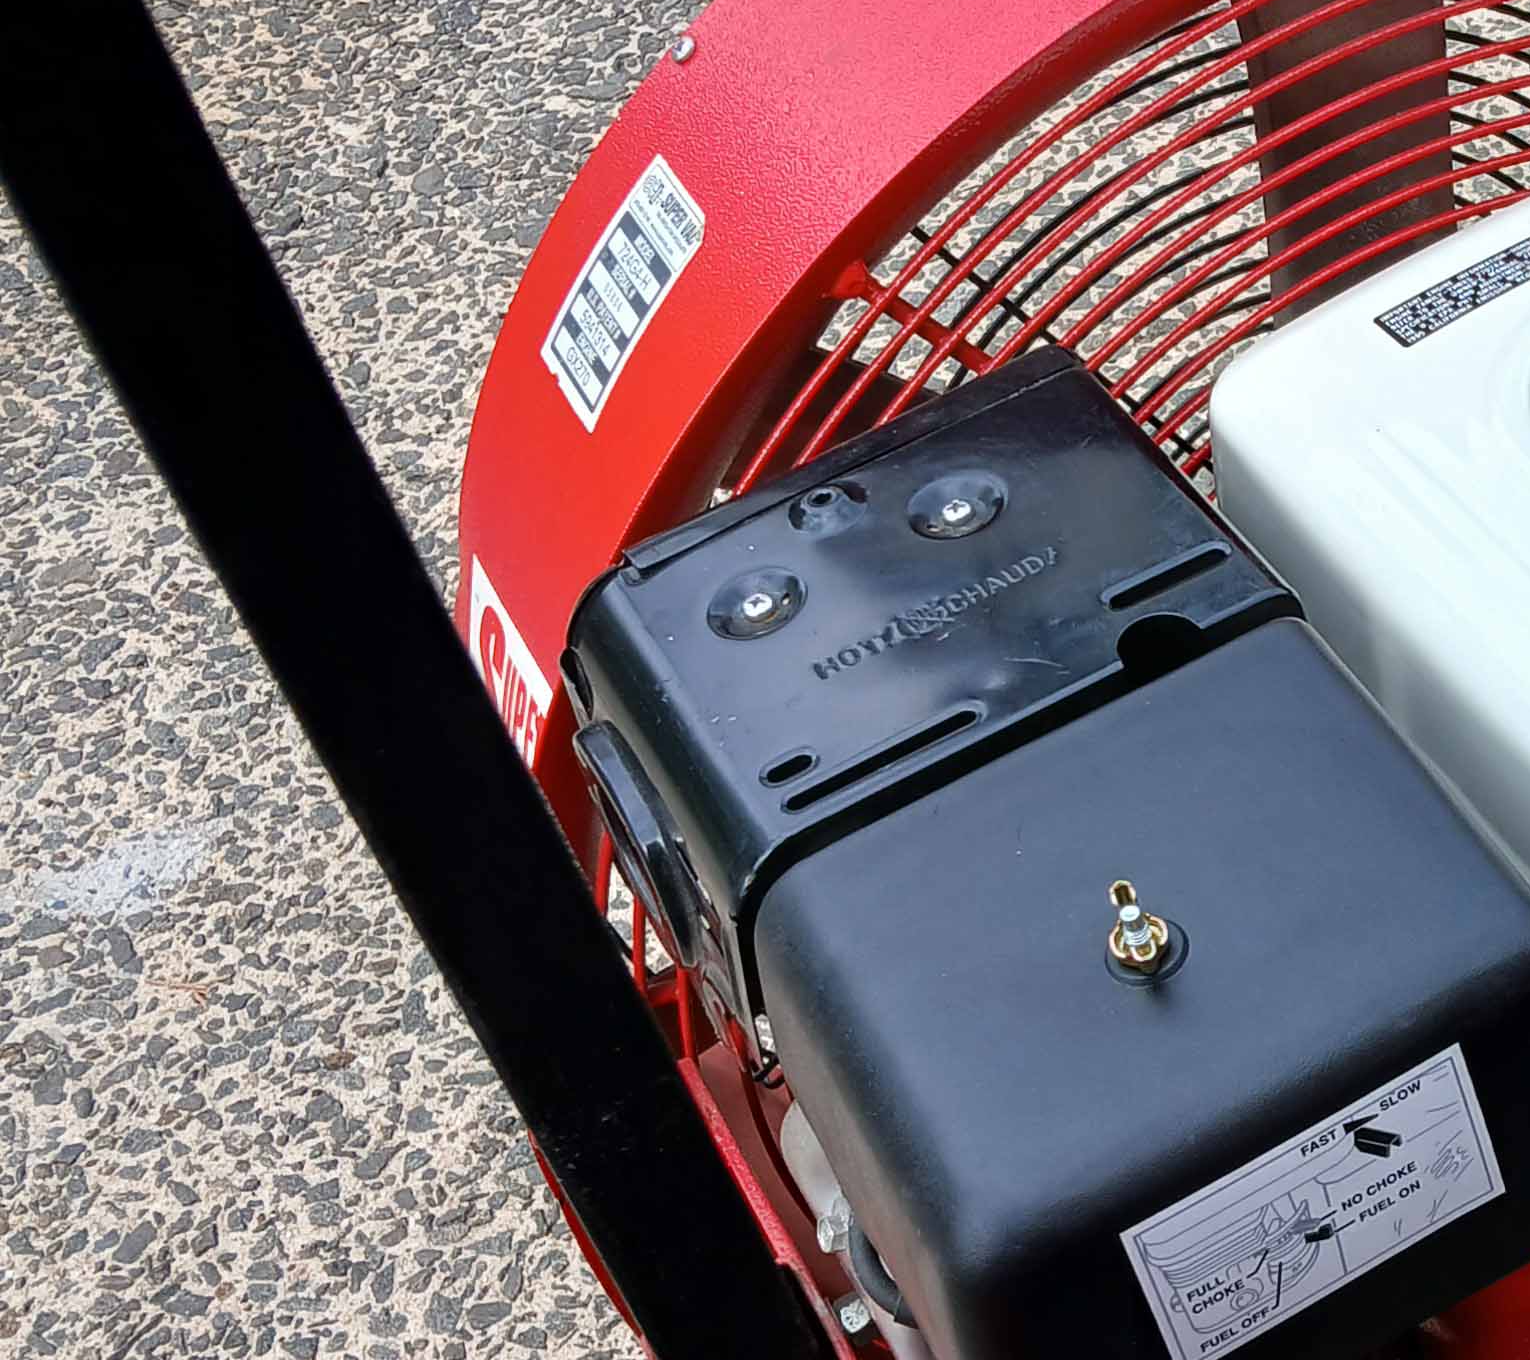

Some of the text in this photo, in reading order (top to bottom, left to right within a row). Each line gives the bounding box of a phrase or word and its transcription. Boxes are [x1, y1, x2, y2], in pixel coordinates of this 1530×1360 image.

[566, 346, 591, 386] GX270
[1300, 1080, 1421, 1157] FAST SLOW
[1341, 1161, 1416, 1211] NO CHOKE
[1359, 1180, 1421, 1222] FUEL ON
[1186, 1277, 1225, 1302] FULL
[1192, 1279, 1245, 1314] CHOKE
[1200, 1306, 1270, 1353] FUEL OFF
